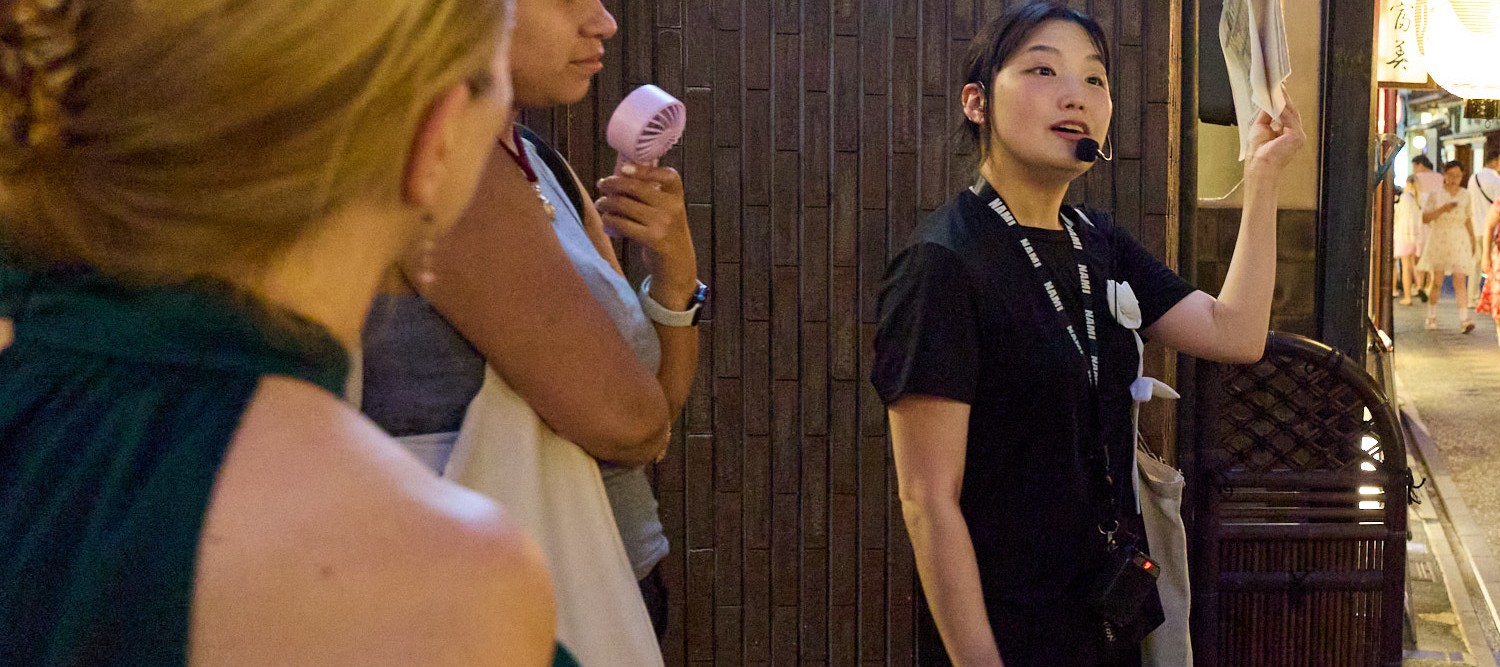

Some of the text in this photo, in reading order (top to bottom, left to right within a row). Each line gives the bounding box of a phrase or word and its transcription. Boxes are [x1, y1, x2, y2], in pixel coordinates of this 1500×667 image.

[988, 198, 1016, 226] NAMI
[1020, 238, 1042, 268] NAMI
[1078, 264, 1091, 294] NAMI
[1044, 281, 1064, 312] NAMI
[1084, 309, 1097, 340] NAMI
